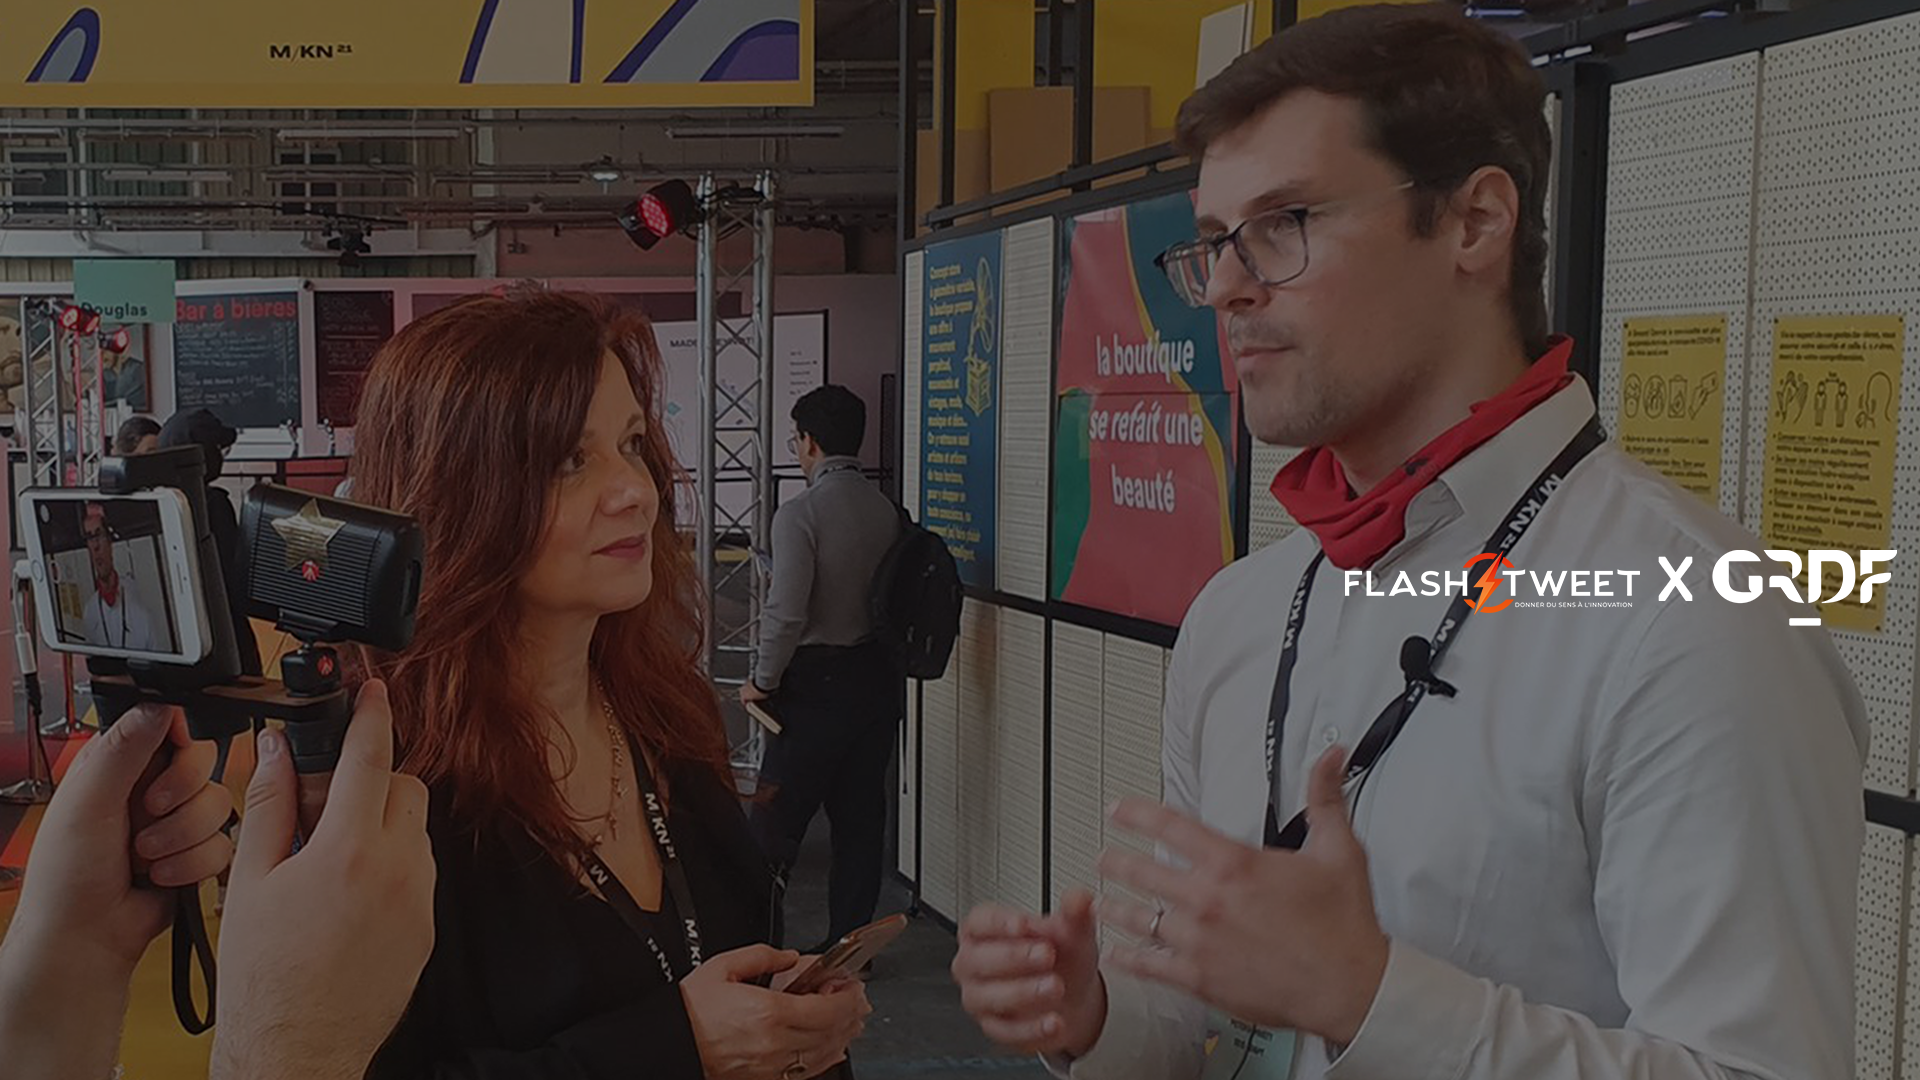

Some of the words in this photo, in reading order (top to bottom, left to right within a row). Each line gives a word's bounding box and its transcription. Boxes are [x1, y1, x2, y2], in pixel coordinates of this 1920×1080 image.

[1096, 335, 1110, 376] la
[1114, 330, 1195, 384] boutique
[1089, 410, 1109, 440] se
[1111, 400, 1162, 443] refait
[1165, 413, 1204, 446] une
[1111, 463, 1175, 513] beauté
